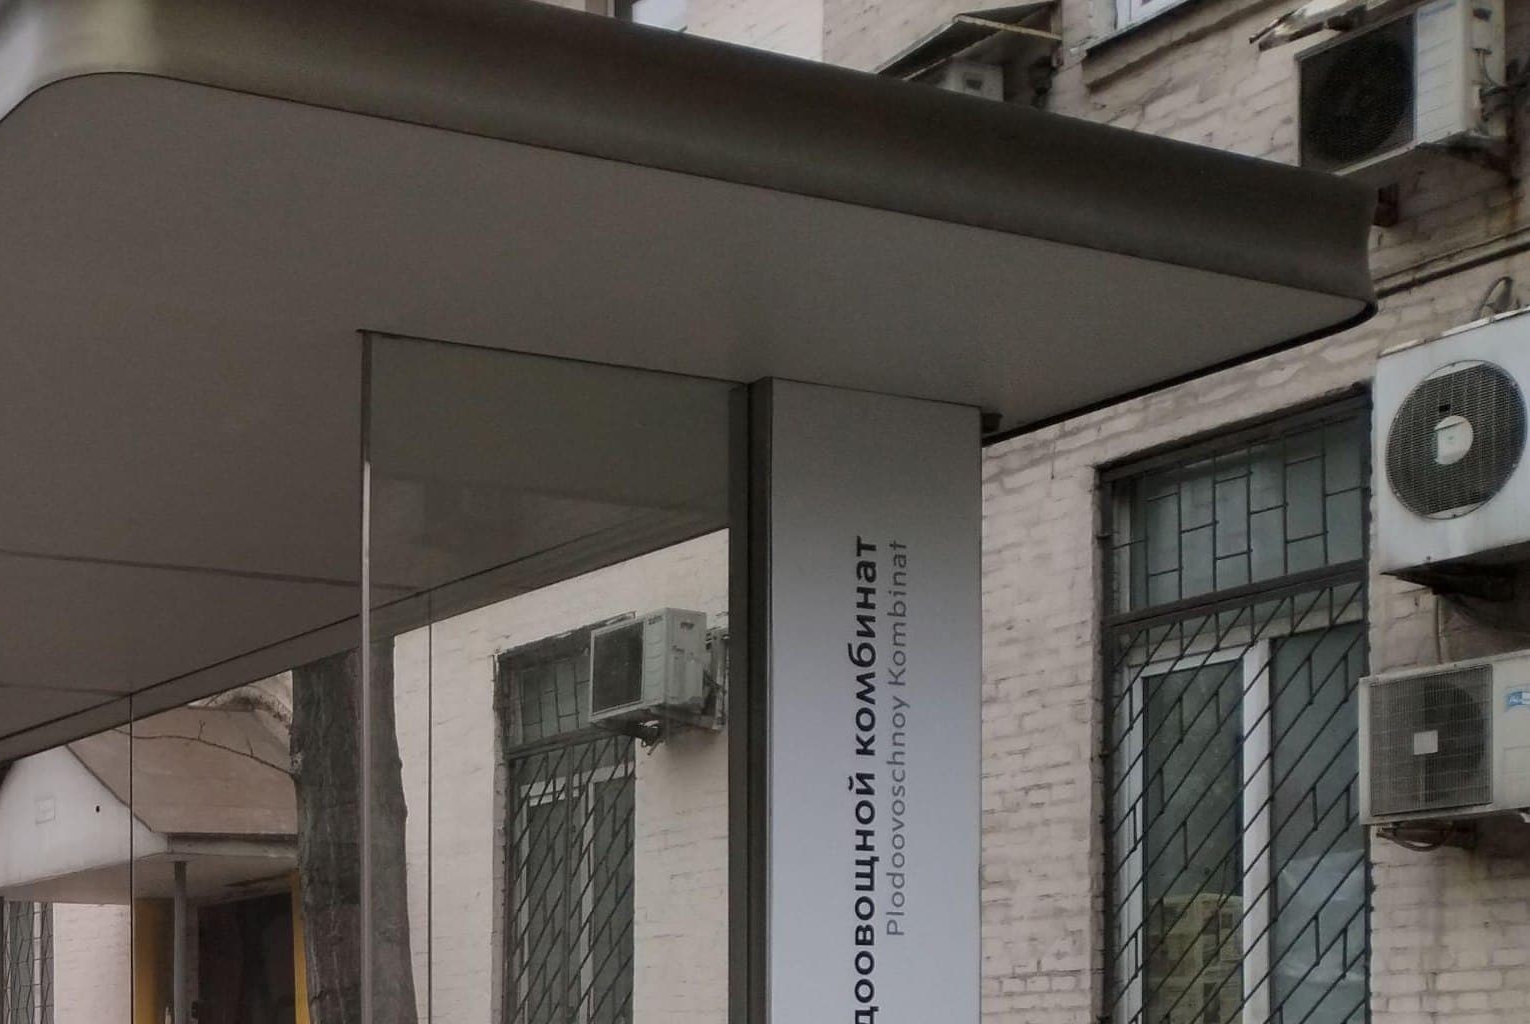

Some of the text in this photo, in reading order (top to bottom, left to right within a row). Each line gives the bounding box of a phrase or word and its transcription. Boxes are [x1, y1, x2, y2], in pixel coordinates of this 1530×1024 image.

[846, 535, 878, 757] комбинат
[885, 540, 911, 937] Plodoovoschnoy Kombinat
